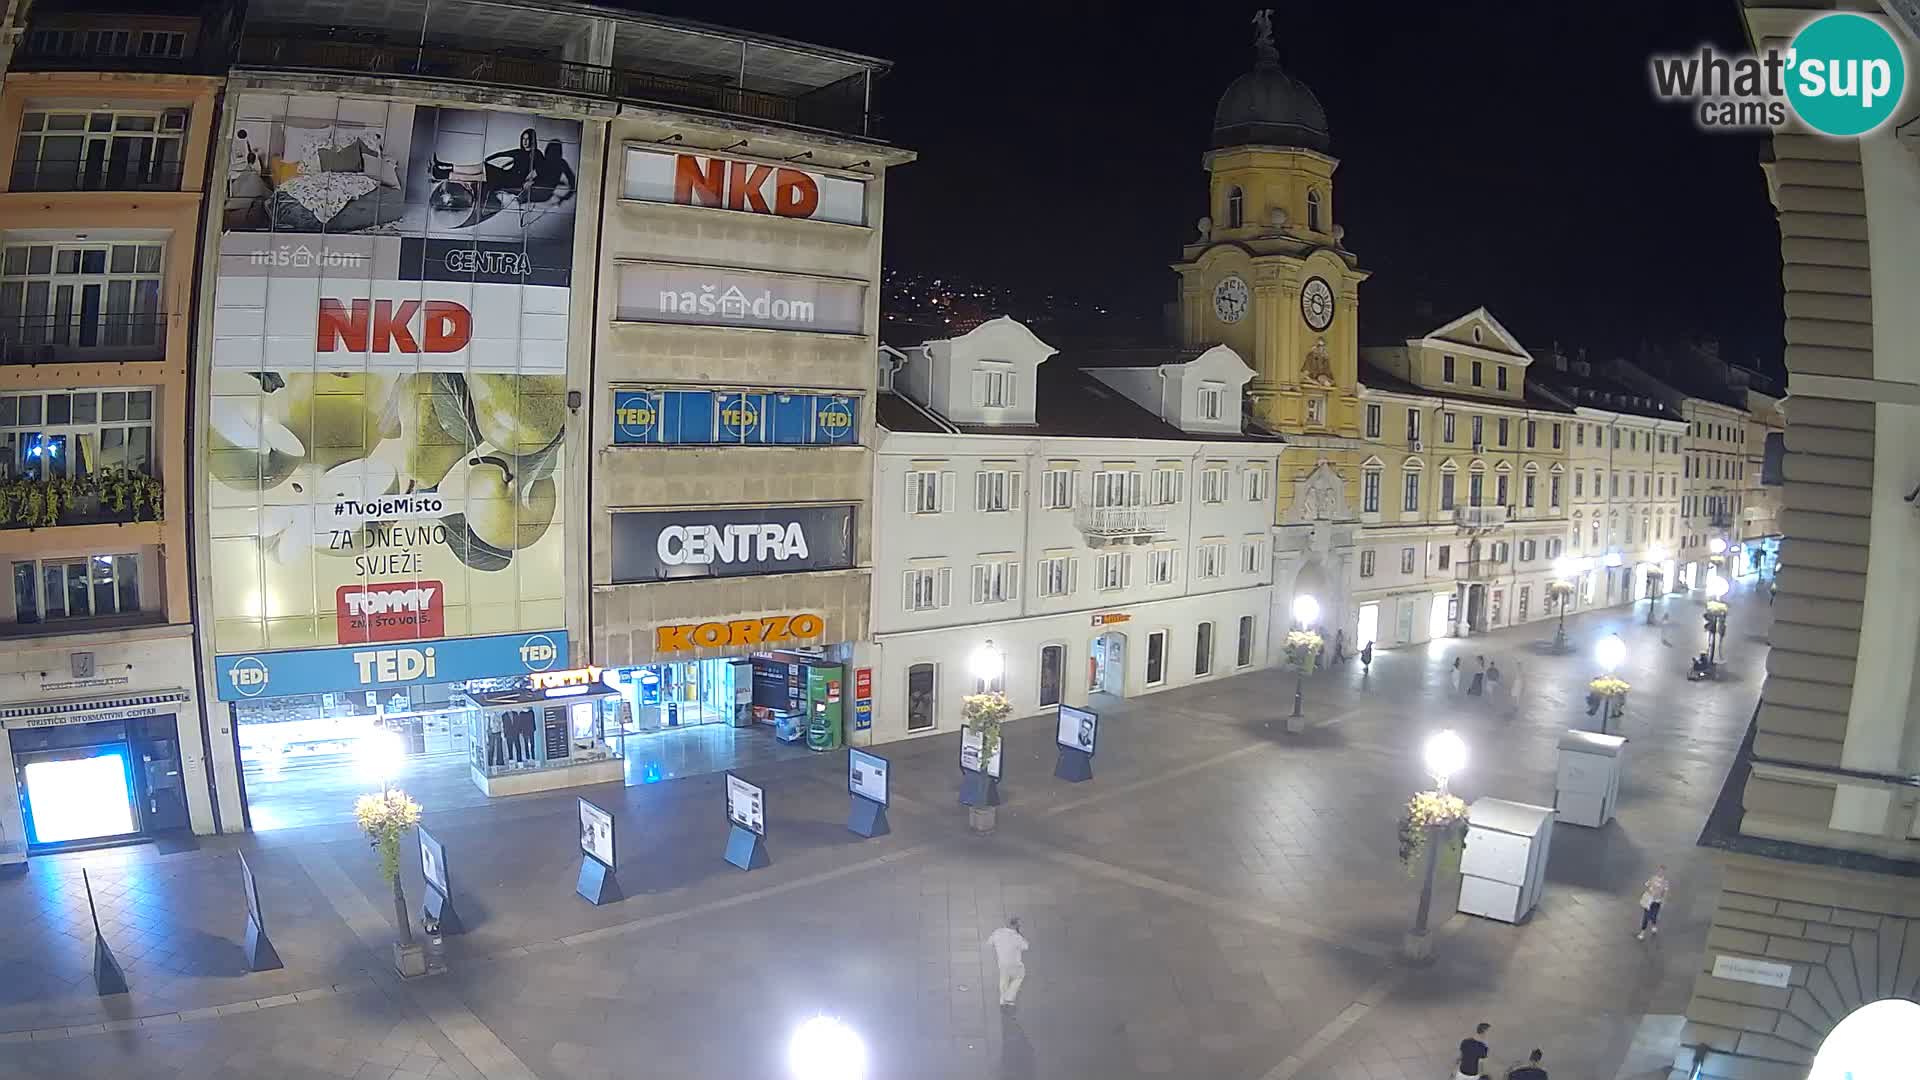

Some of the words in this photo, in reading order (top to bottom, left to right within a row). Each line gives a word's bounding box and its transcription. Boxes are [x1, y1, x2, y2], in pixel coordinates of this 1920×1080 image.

[673, 153, 820, 219] NKD
[250, 246, 290, 267] naš
[316, 246, 361, 268] dom
[445, 249, 532, 275] CENTRA
[659, 284, 716, 317] naš
[752, 290, 815, 323] dom
[316, 298, 473, 353] NKD
[616, 409, 656, 425] TEDi
[722, 409, 758, 426] TEDi
[335, 499, 443, 518] #TvojeMisto
[329, 529, 354, 550] ZA
[365, 525, 447, 548] DNEVNO
[656, 522, 809, 566] CENTRA
[355, 549, 422, 576] SVJEŽE
[344, 587, 436, 616] TOMMY
[375, 615, 396, 627] ŠTO
[656, 614, 824, 653] KORZO
[354, 647, 437, 684] TEDi
[520, 644, 557, 662] TEDi
[229, 667, 269, 688] TEDi
[530, 665, 604, 690] TOMMY
